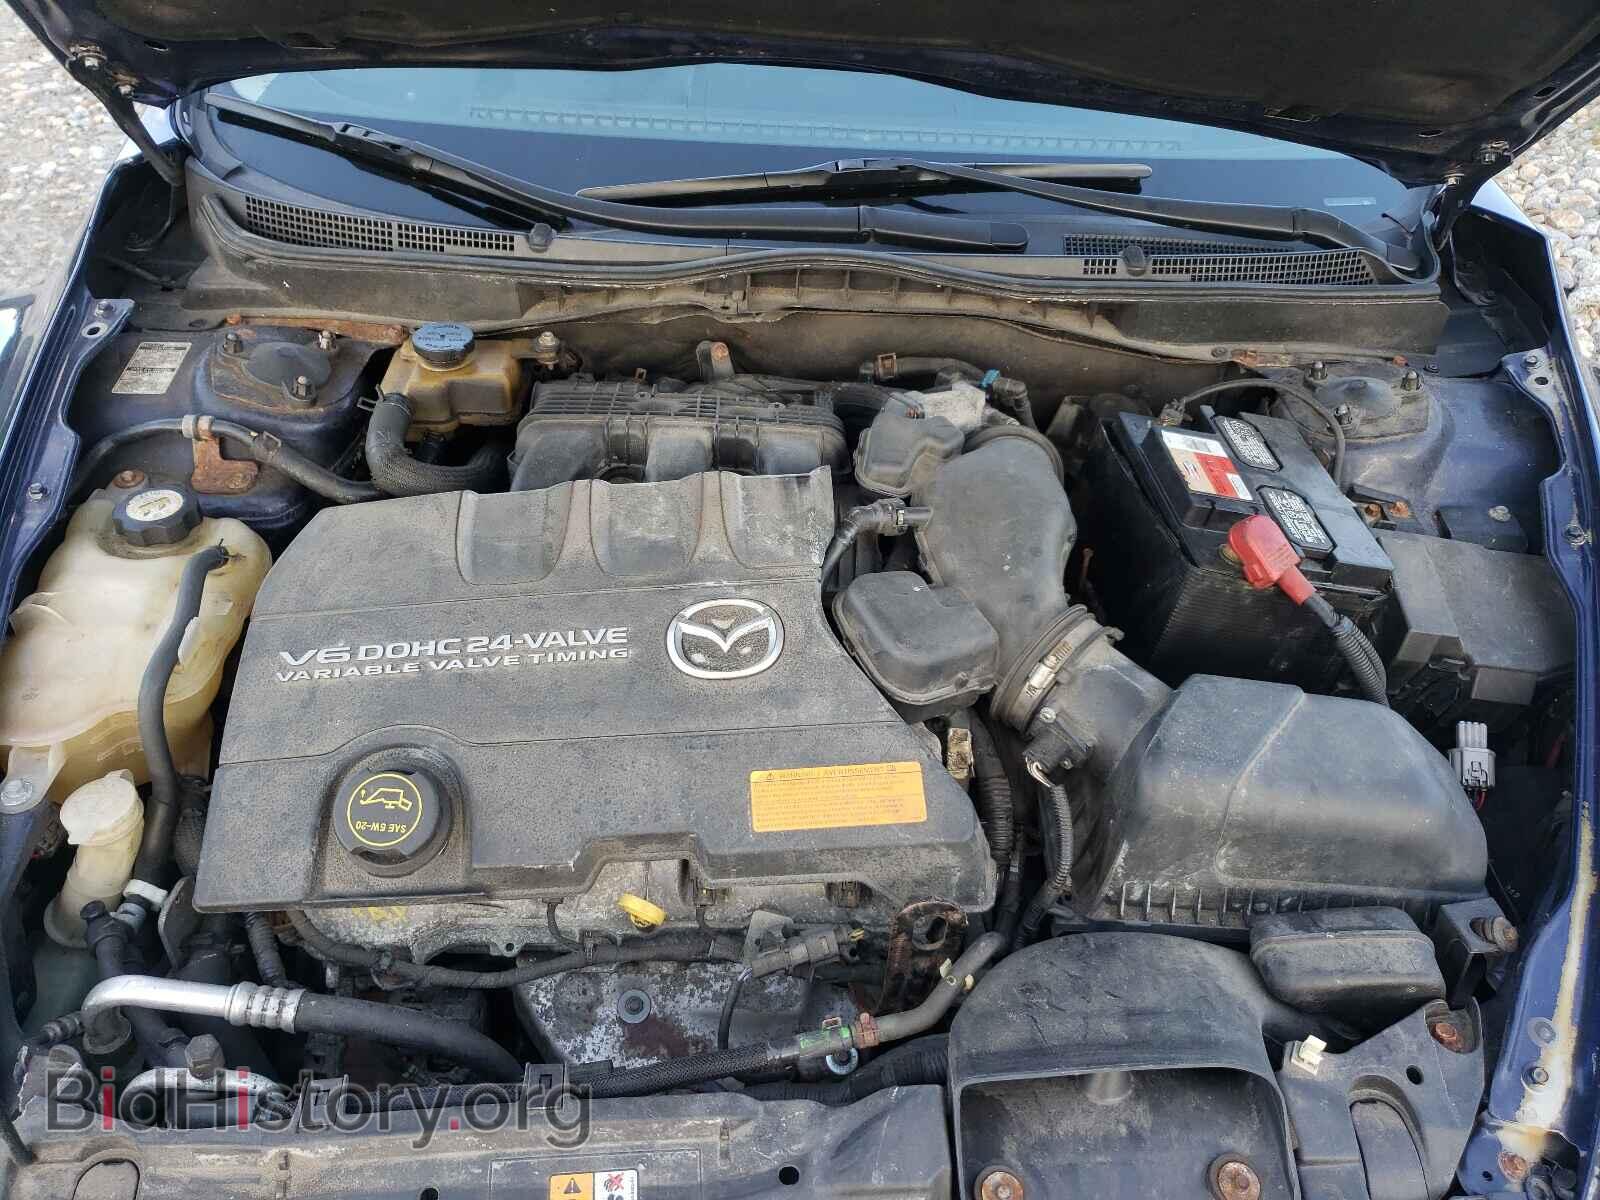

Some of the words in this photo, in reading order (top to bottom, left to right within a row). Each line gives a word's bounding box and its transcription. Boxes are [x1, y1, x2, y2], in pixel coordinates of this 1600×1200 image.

[276, 662, 420, 682] VARIABLE
[429, 654, 521, 672] VALVE
[527, 647, 631, 664] TIMING
[279, 645, 351, 667] V6
[356, 638, 464, 661] DOHC
[466, 627, 629, 653] 24-VALVE
[388, 823, 407, 834] SAE
